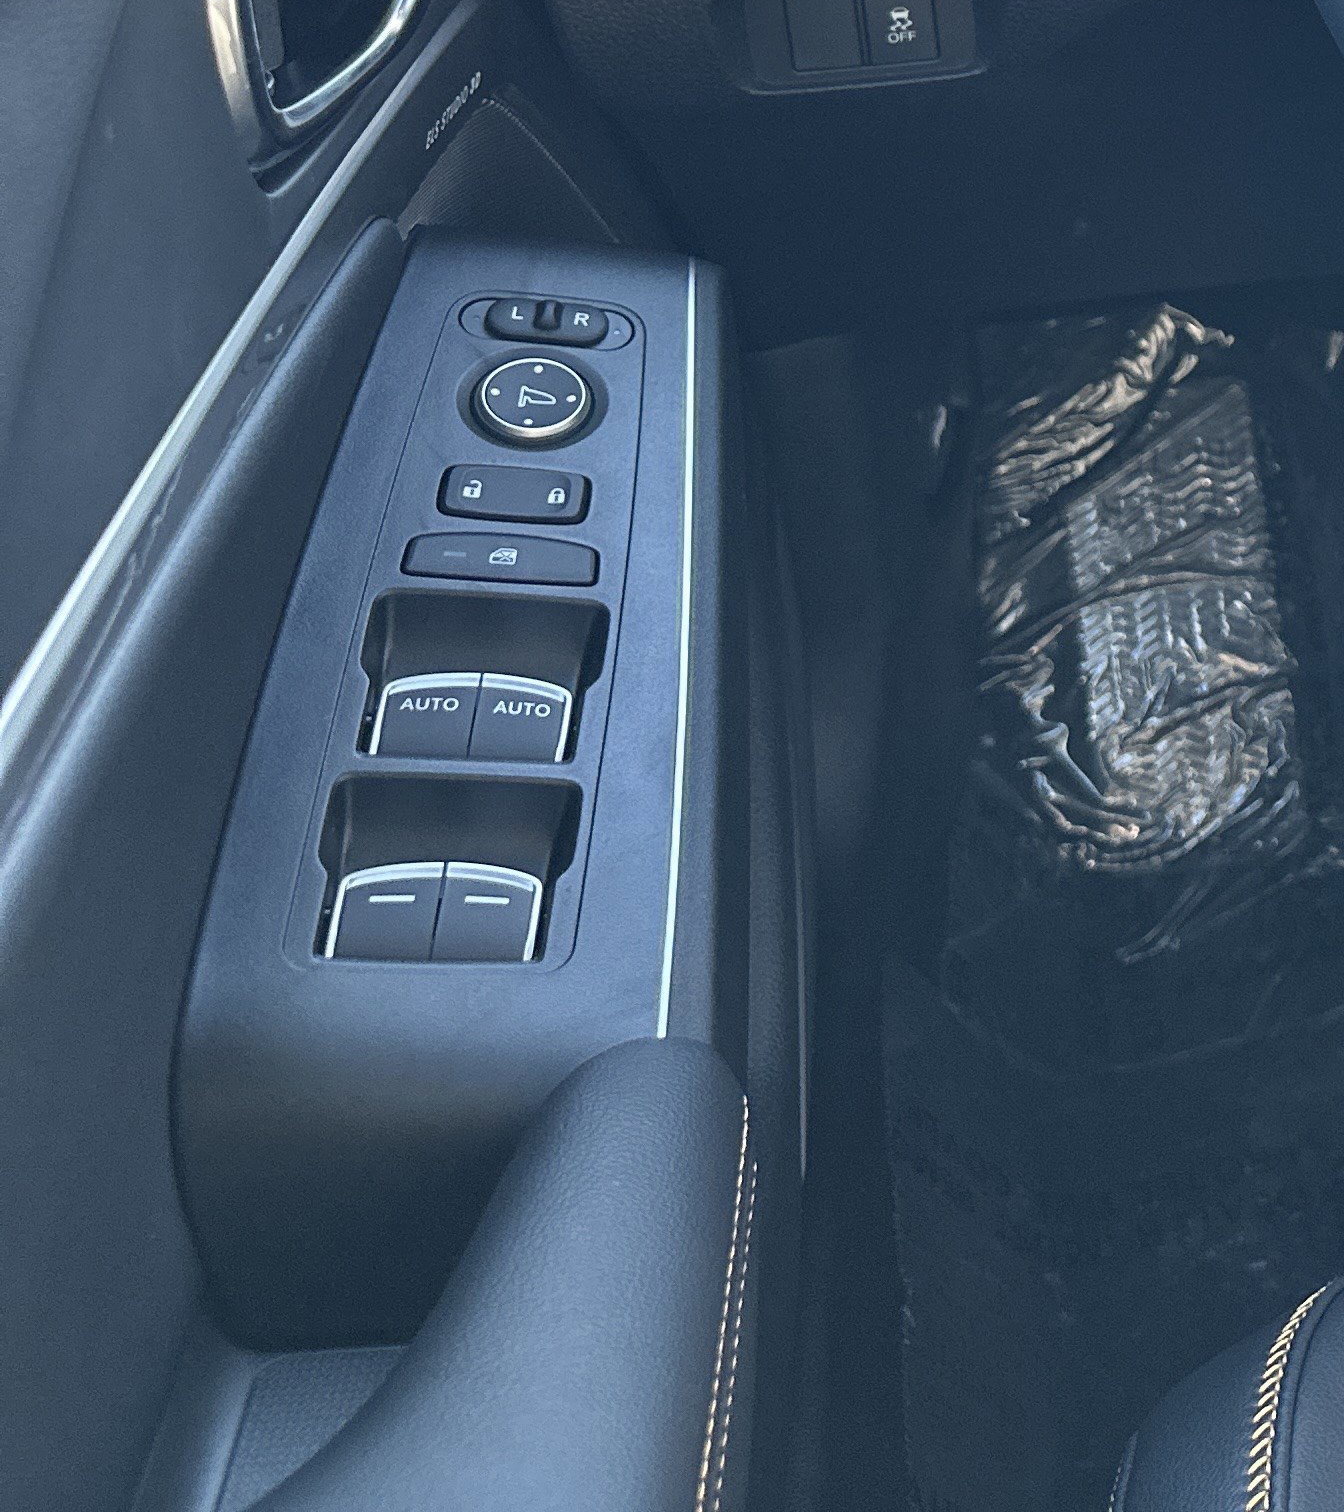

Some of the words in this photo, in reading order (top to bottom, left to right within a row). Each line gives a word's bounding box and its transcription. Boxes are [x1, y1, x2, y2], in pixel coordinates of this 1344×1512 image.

[888, 30, 917, 44] OFF
[512, 305, 524, 321] L
[573, 311, 591, 327] R
[400, 696, 460, 713] AUTO
[493, 700, 552, 718] AUTO
